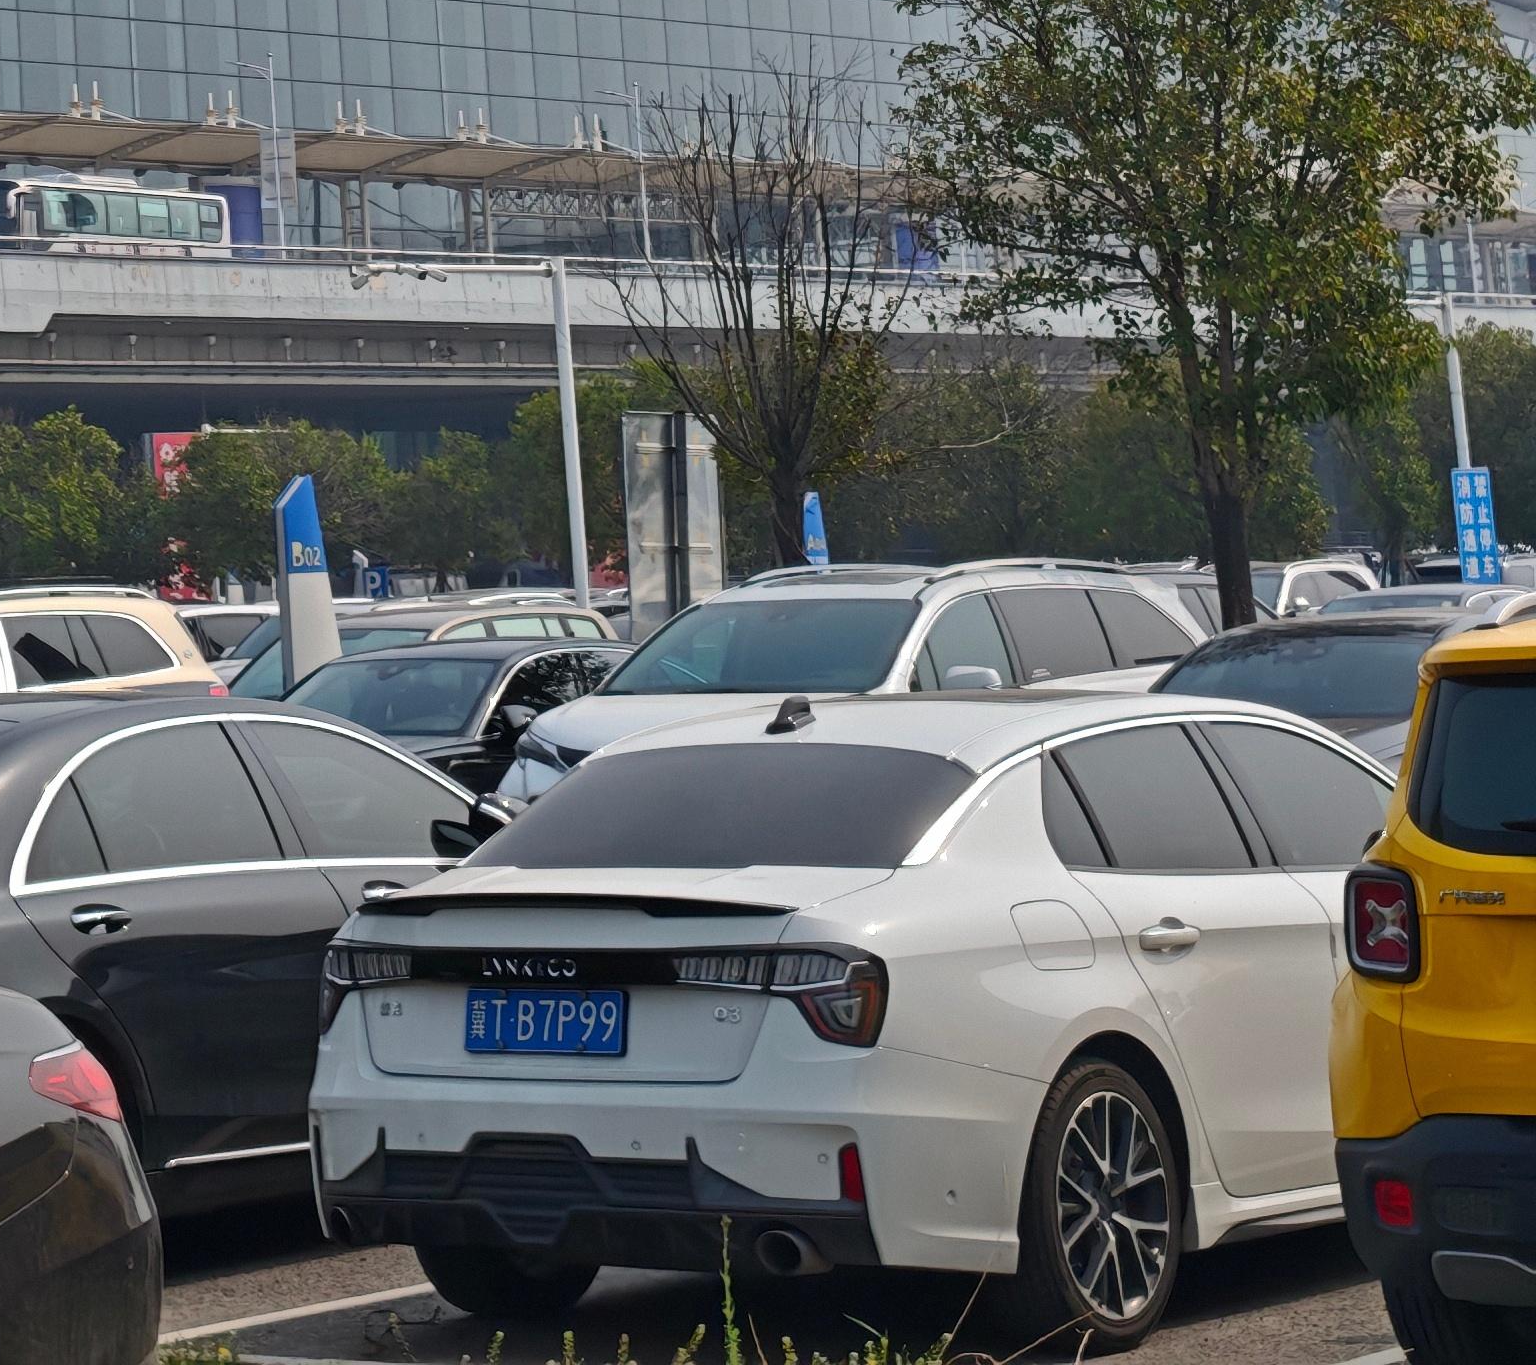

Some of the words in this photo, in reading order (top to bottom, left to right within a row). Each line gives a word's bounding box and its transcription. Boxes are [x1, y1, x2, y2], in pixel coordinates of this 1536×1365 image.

[1474, 475, 1495, 577] 禁止停车
[291, 541, 322, 567] B02
[366, 571, 382, 598] P
[714, 1006, 740, 1023] 03
